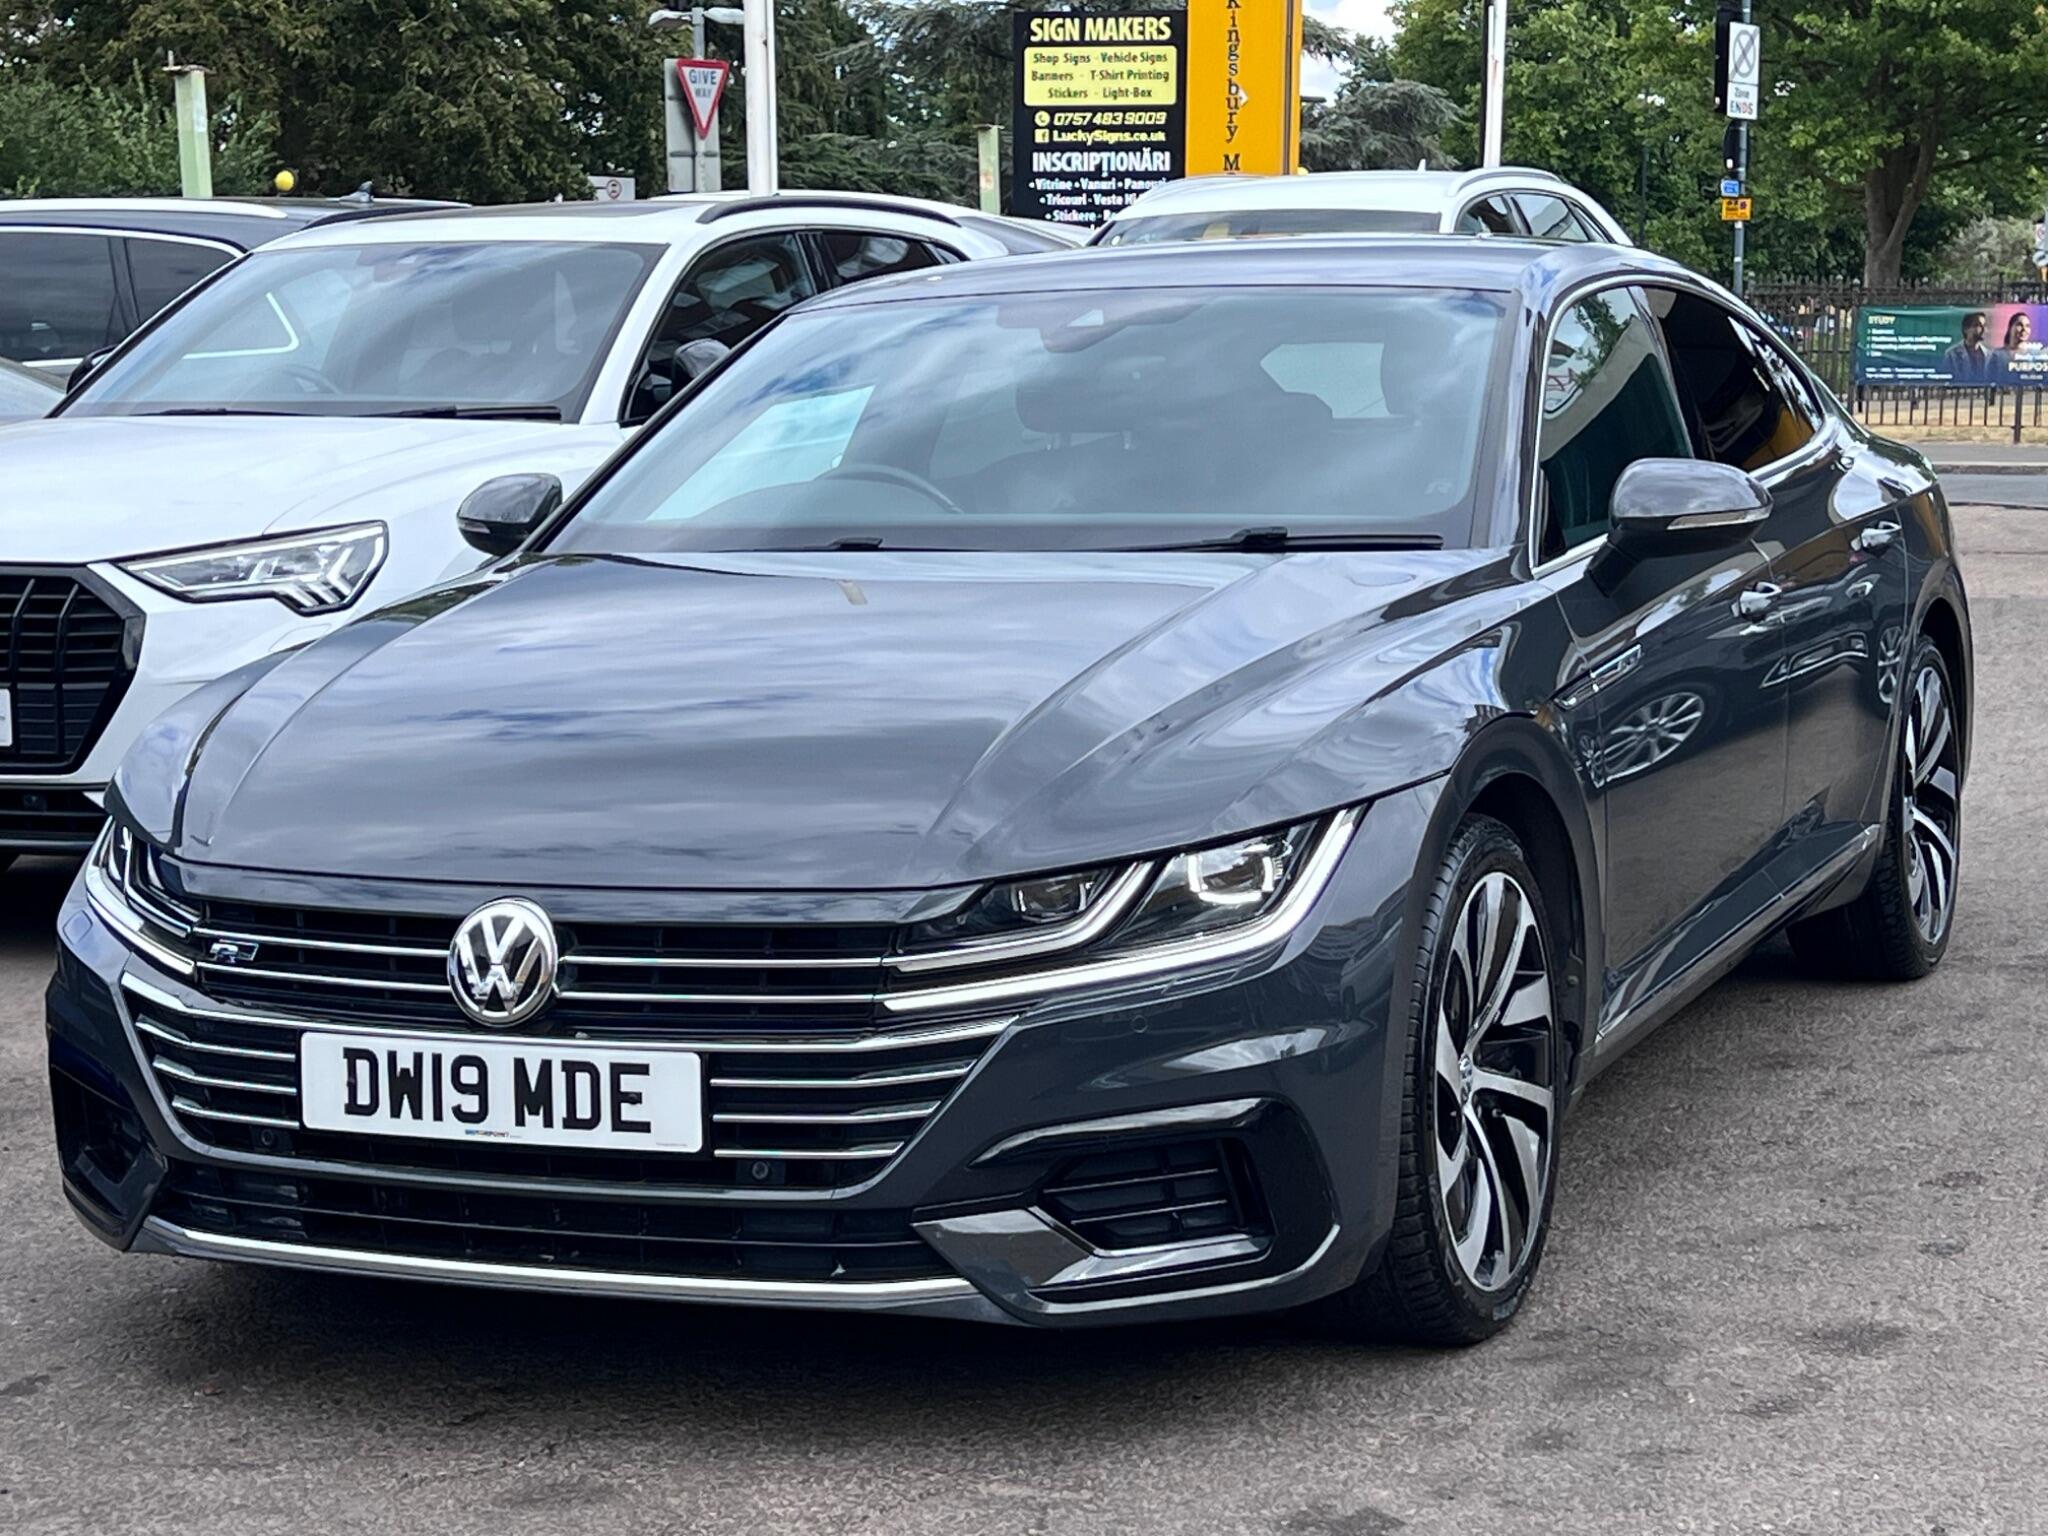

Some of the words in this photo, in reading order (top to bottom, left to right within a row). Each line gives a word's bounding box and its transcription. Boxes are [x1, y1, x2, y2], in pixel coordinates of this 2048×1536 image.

[1030, 18, 1080, 42] SIGN
[1085, 17, 1172, 41] MAKERS
[1033, 53, 1059, 65] Shop
[1063, 52, 1091, 65] Signs
[1100, 52, 1138, 63] Vehicle
[1140, 52, 1168, 65] Signs
[688, 69, 717, 85] GIVE
[1032, 70, 1074, 81] Banners
[1090, 69, 1124, 80] T-Shirt
[1126, 69, 1170, 82] Printing
[695, 87, 713, 98] WAY
[1047, 87, 1089, 98] Stickers
[1102, 87, 1153, 100] Light-Box
[1730, 100, 1754, 115] ENDS
[1052, 129, 1167, 146] LuckySigns.co.uk
[1222, 154, 1241, 175] M
[342, 1046, 489, 1125] DW19
[513, 1057, 652, 1134] MDE
